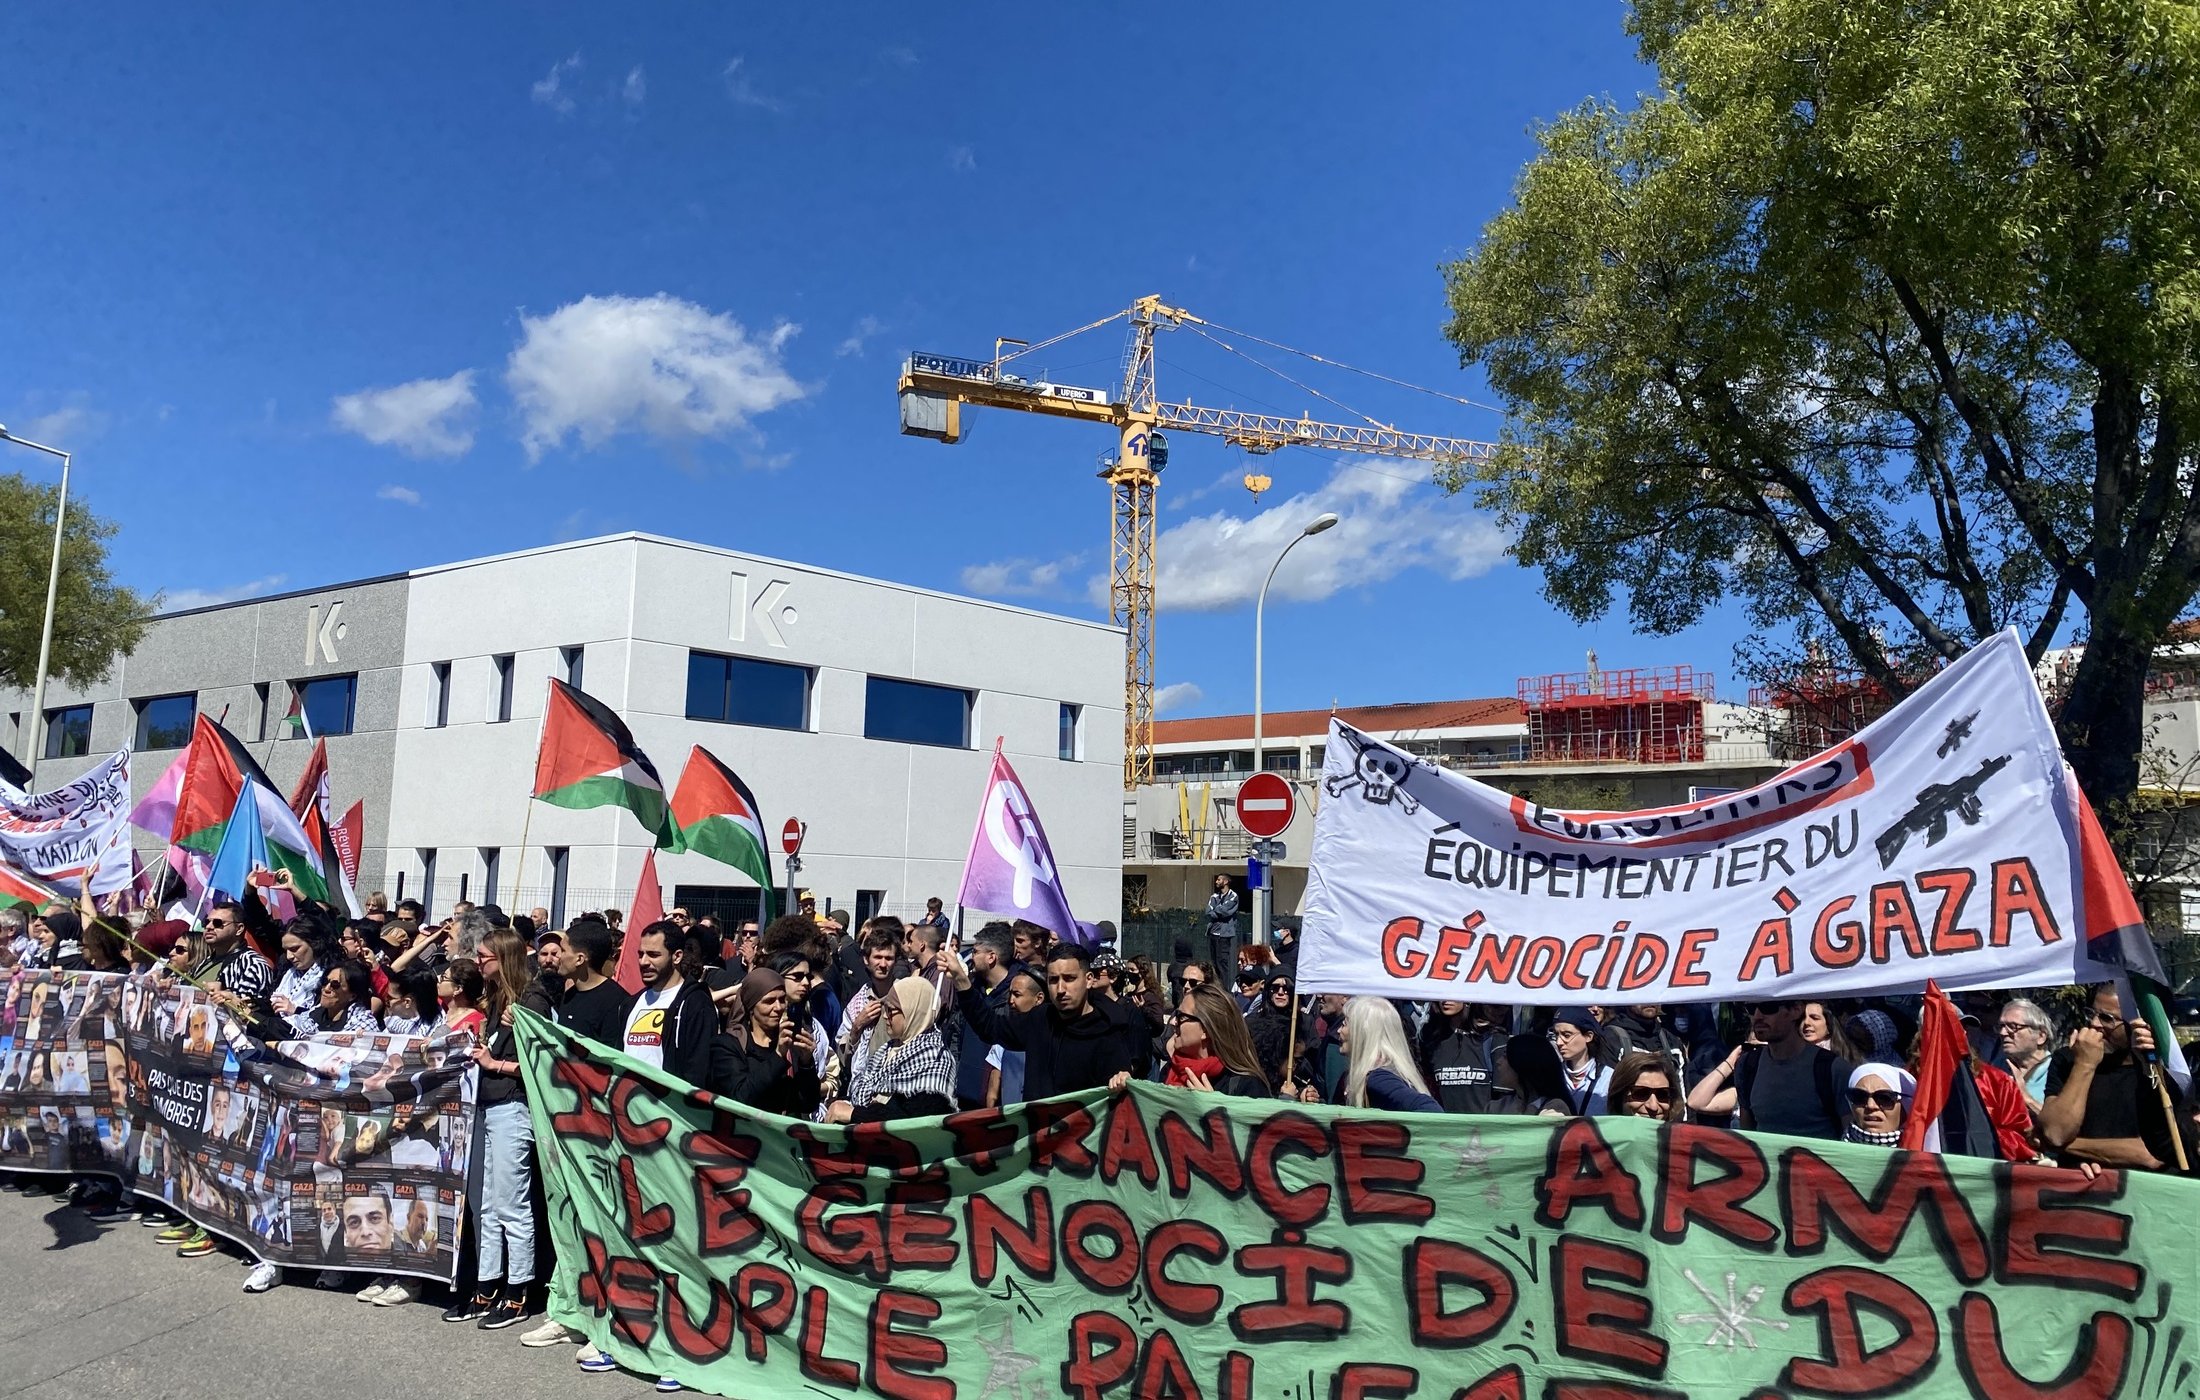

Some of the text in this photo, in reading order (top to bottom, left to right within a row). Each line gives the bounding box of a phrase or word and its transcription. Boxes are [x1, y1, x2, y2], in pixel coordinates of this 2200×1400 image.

[914, 355, 978, 376] POTAIN
[1804, 808, 1859, 869] DU
[1737, 886, 1801, 982] À
[1810, 856, 2062, 969] GAZA
[147, 1068, 166, 1090] PAS
[167, 1075, 181, 1097] QUE
[183, 1080, 203, 1103] DES
[152, 1094, 195, 1128] OMBRES
[292, 1183, 314, 1193] GAZA
[344, 1183, 367, 1193] GAZA
[395, 1185, 415, 1196] GAZA
[943, 1090, 1436, 1229] FRANCE
[1535, 1117, 2146, 1302] ARME
[618, 1154, 767, 1258] LE
[1782, 1265, 2136, 1400] DU
